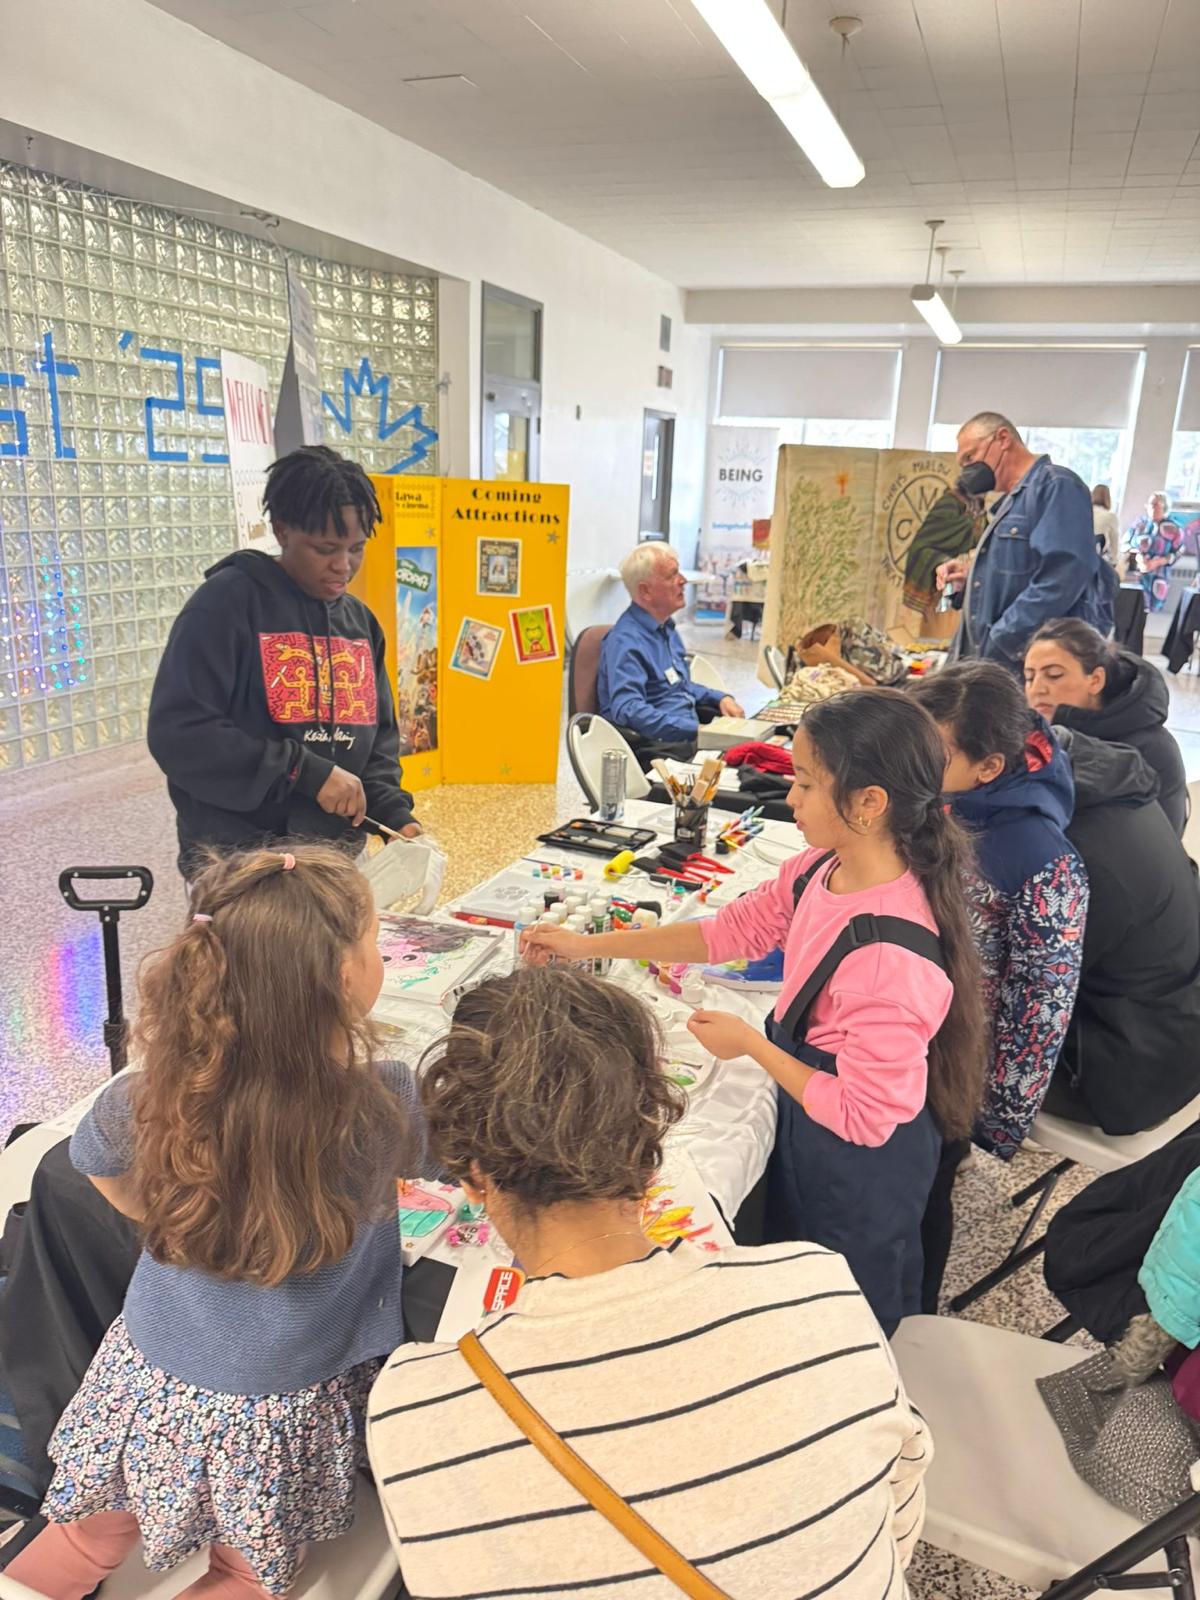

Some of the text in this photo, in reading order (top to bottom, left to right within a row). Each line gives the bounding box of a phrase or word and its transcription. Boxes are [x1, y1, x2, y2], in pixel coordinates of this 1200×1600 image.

[718, 468, 764, 482] BEING
[472, 487, 542, 504] Coming
[452, 507, 561, 525] Attractions
